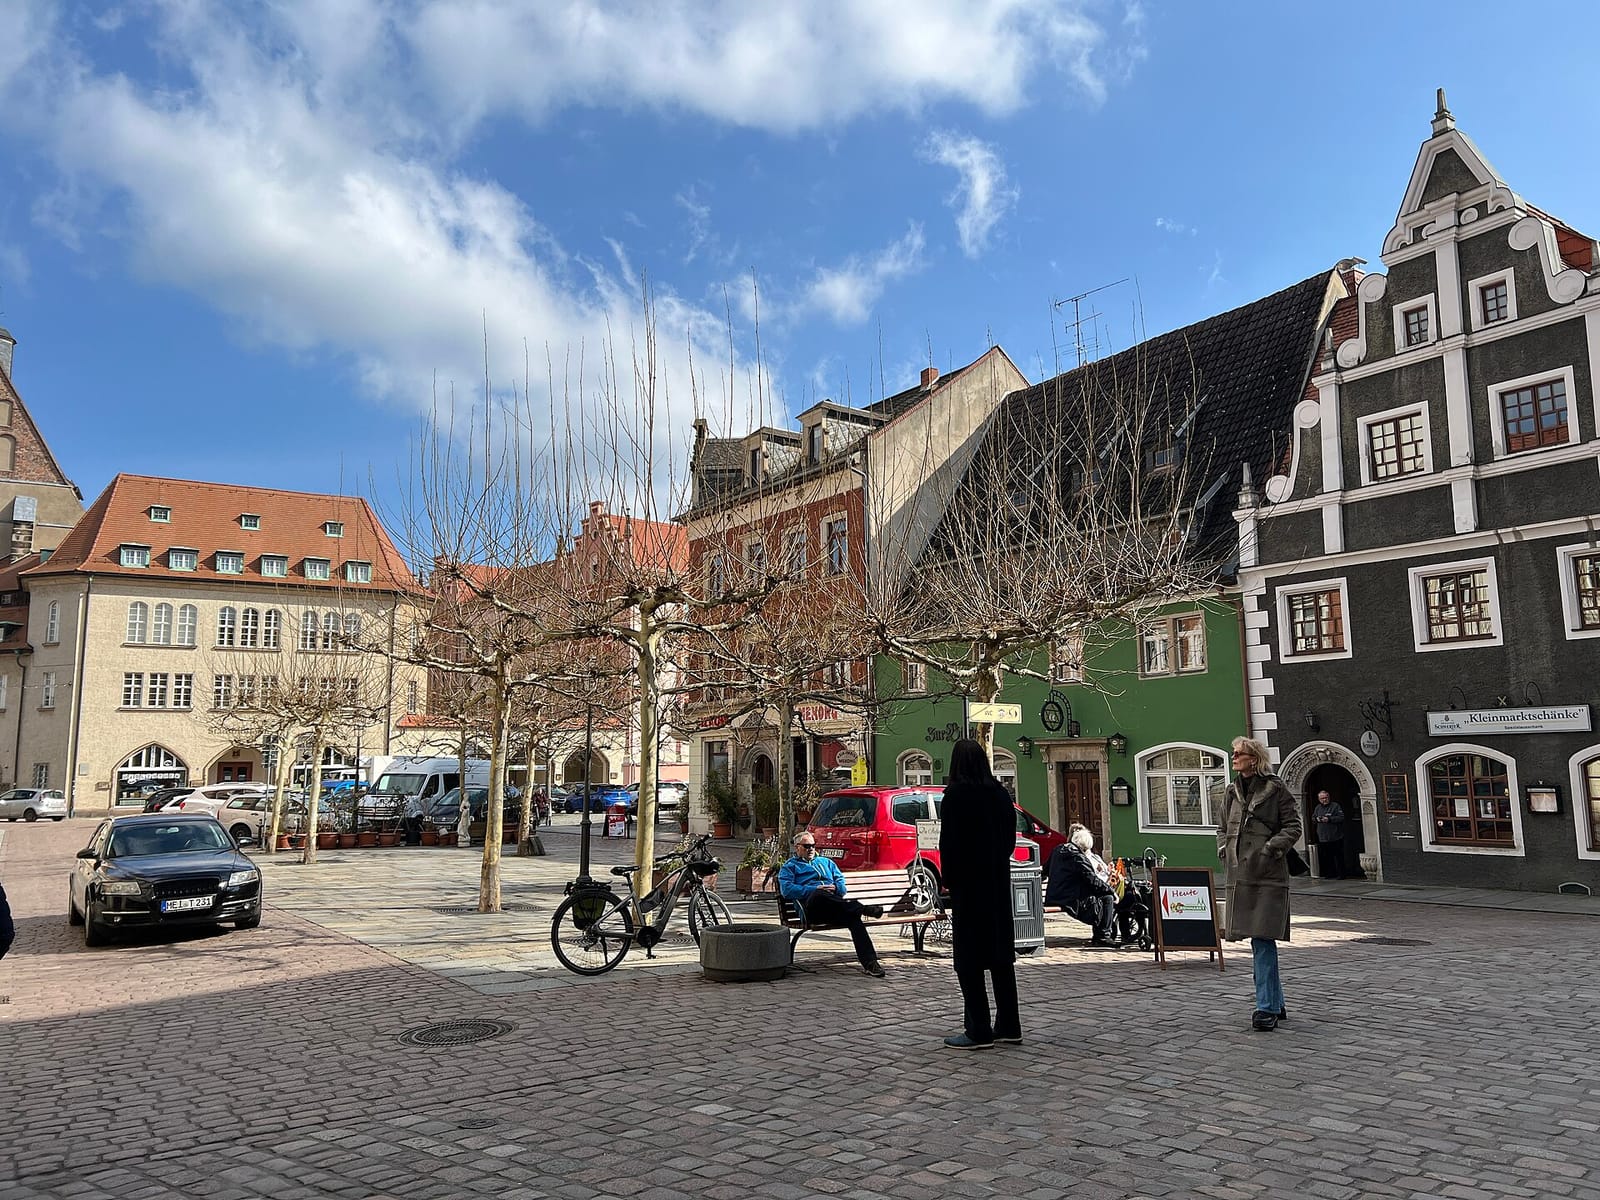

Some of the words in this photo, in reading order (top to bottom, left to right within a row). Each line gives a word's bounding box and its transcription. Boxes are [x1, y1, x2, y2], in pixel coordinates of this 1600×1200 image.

[1390, 761, 1399, 769] 10
[1171, 888, 1199, 898] Heute
[195, 897, 211, 907] 231
